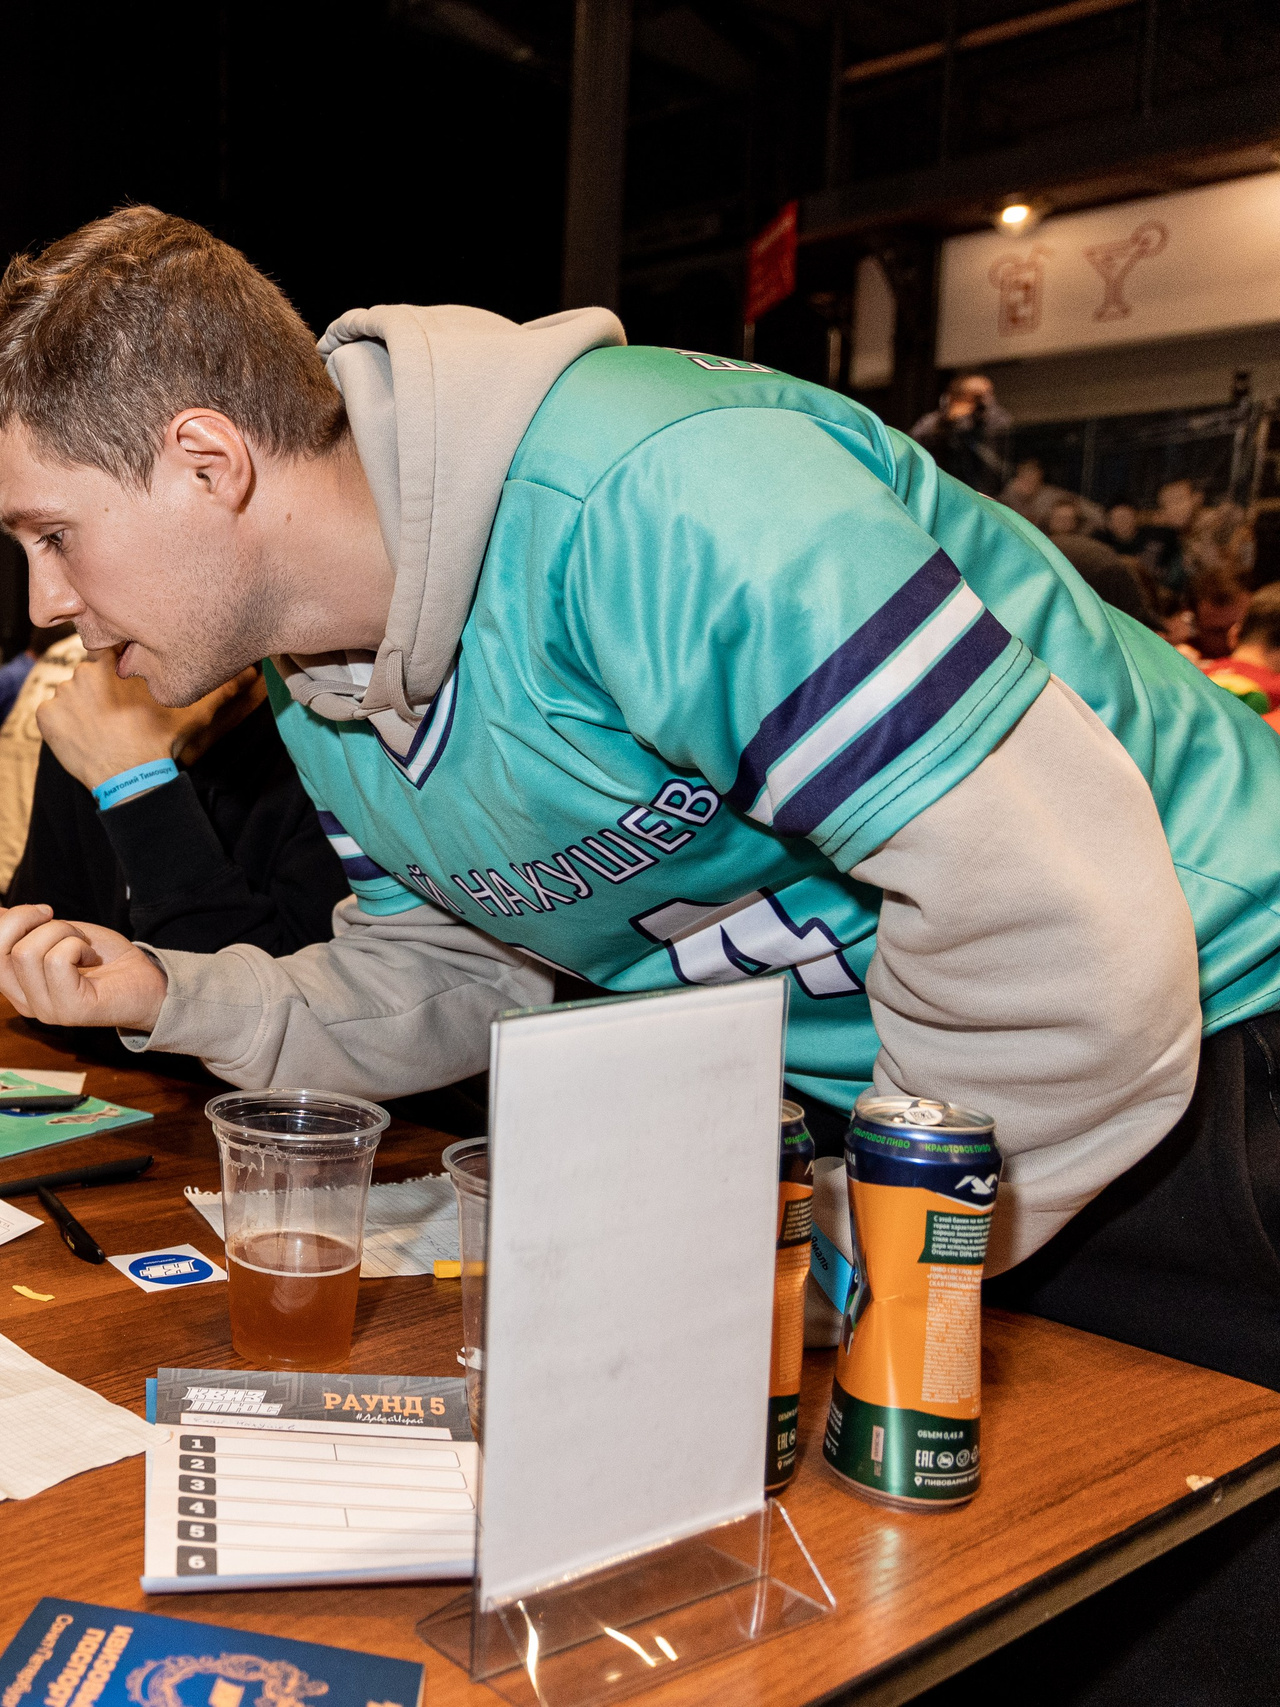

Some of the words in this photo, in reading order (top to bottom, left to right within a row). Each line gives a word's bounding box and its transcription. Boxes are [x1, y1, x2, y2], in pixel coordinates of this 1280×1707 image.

[103, 774, 139, 798] Анатолий
[139, 765, 172, 780] Тимощук
[452, 777, 724, 918] НАХУШЕВ
[887, 1139, 910, 1149] ПИВО
[925, 1143, 974, 1153] КРАФТОВОЕ
[811, 1236, 830, 1271] Ямаль
[181, 1386, 266, 1403] КВИЗ
[188, 1400, 283, 1415] ПЛЮС
[323, 1392, 424, 1417] РАУНД
[430, 1396, 445, 1415] 5
[917, 1430, 943, 1439] ОБЪЕМ
[191, 1439, 204, 1449] 1
[190, 1459, 205, 1470] 2
[915, 1449, 935, 1468] EAC
[190, 1479, 205, 1491] 3
[188, 1501, 205, 1514] 4
[189, 1525, 205, 1538] 5
[188, 1554, 206, 1569] 6
